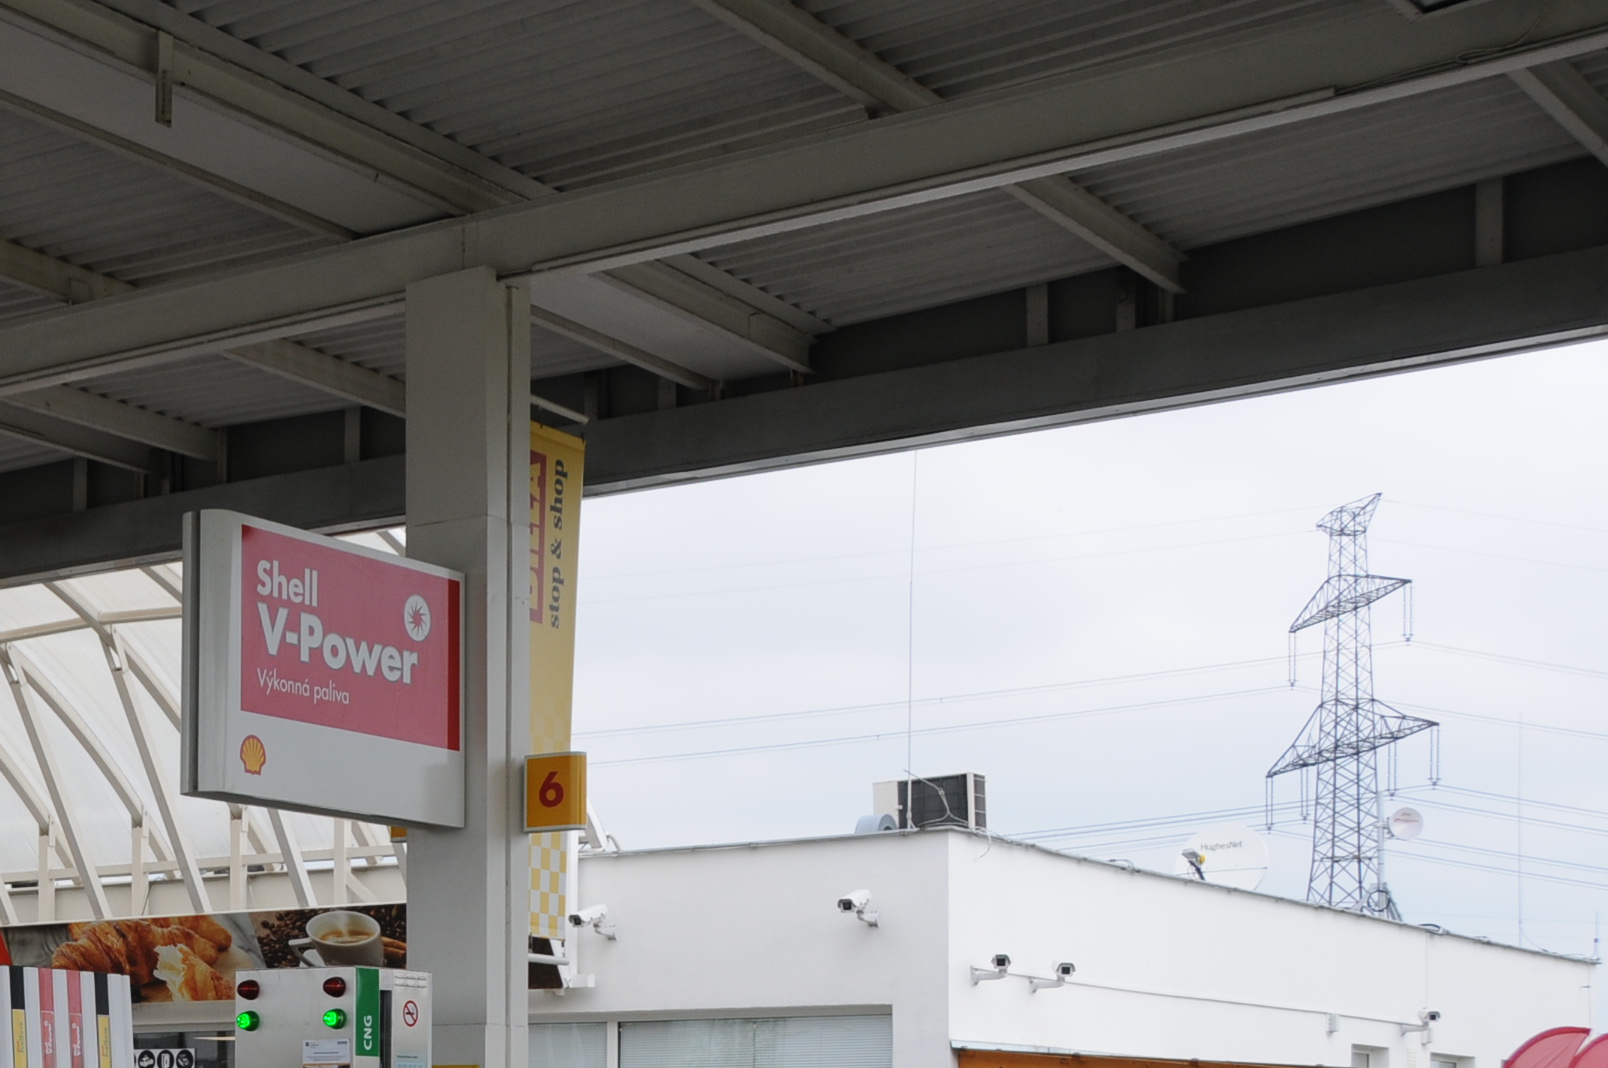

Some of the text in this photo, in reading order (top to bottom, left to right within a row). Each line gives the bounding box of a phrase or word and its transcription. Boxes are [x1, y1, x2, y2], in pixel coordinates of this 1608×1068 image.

[549, 459, 568, 629] stop & shop
[256, 558, 318, 607] Shell
[256, 602, 418, 685] V-Power
[257, 667, 349, 705] Výkonná paliva
[538, 771, 565, 808] 6
[1201, 841, 1243, 852] HughesNet
[363, 1015, 373, 1051] CNG
